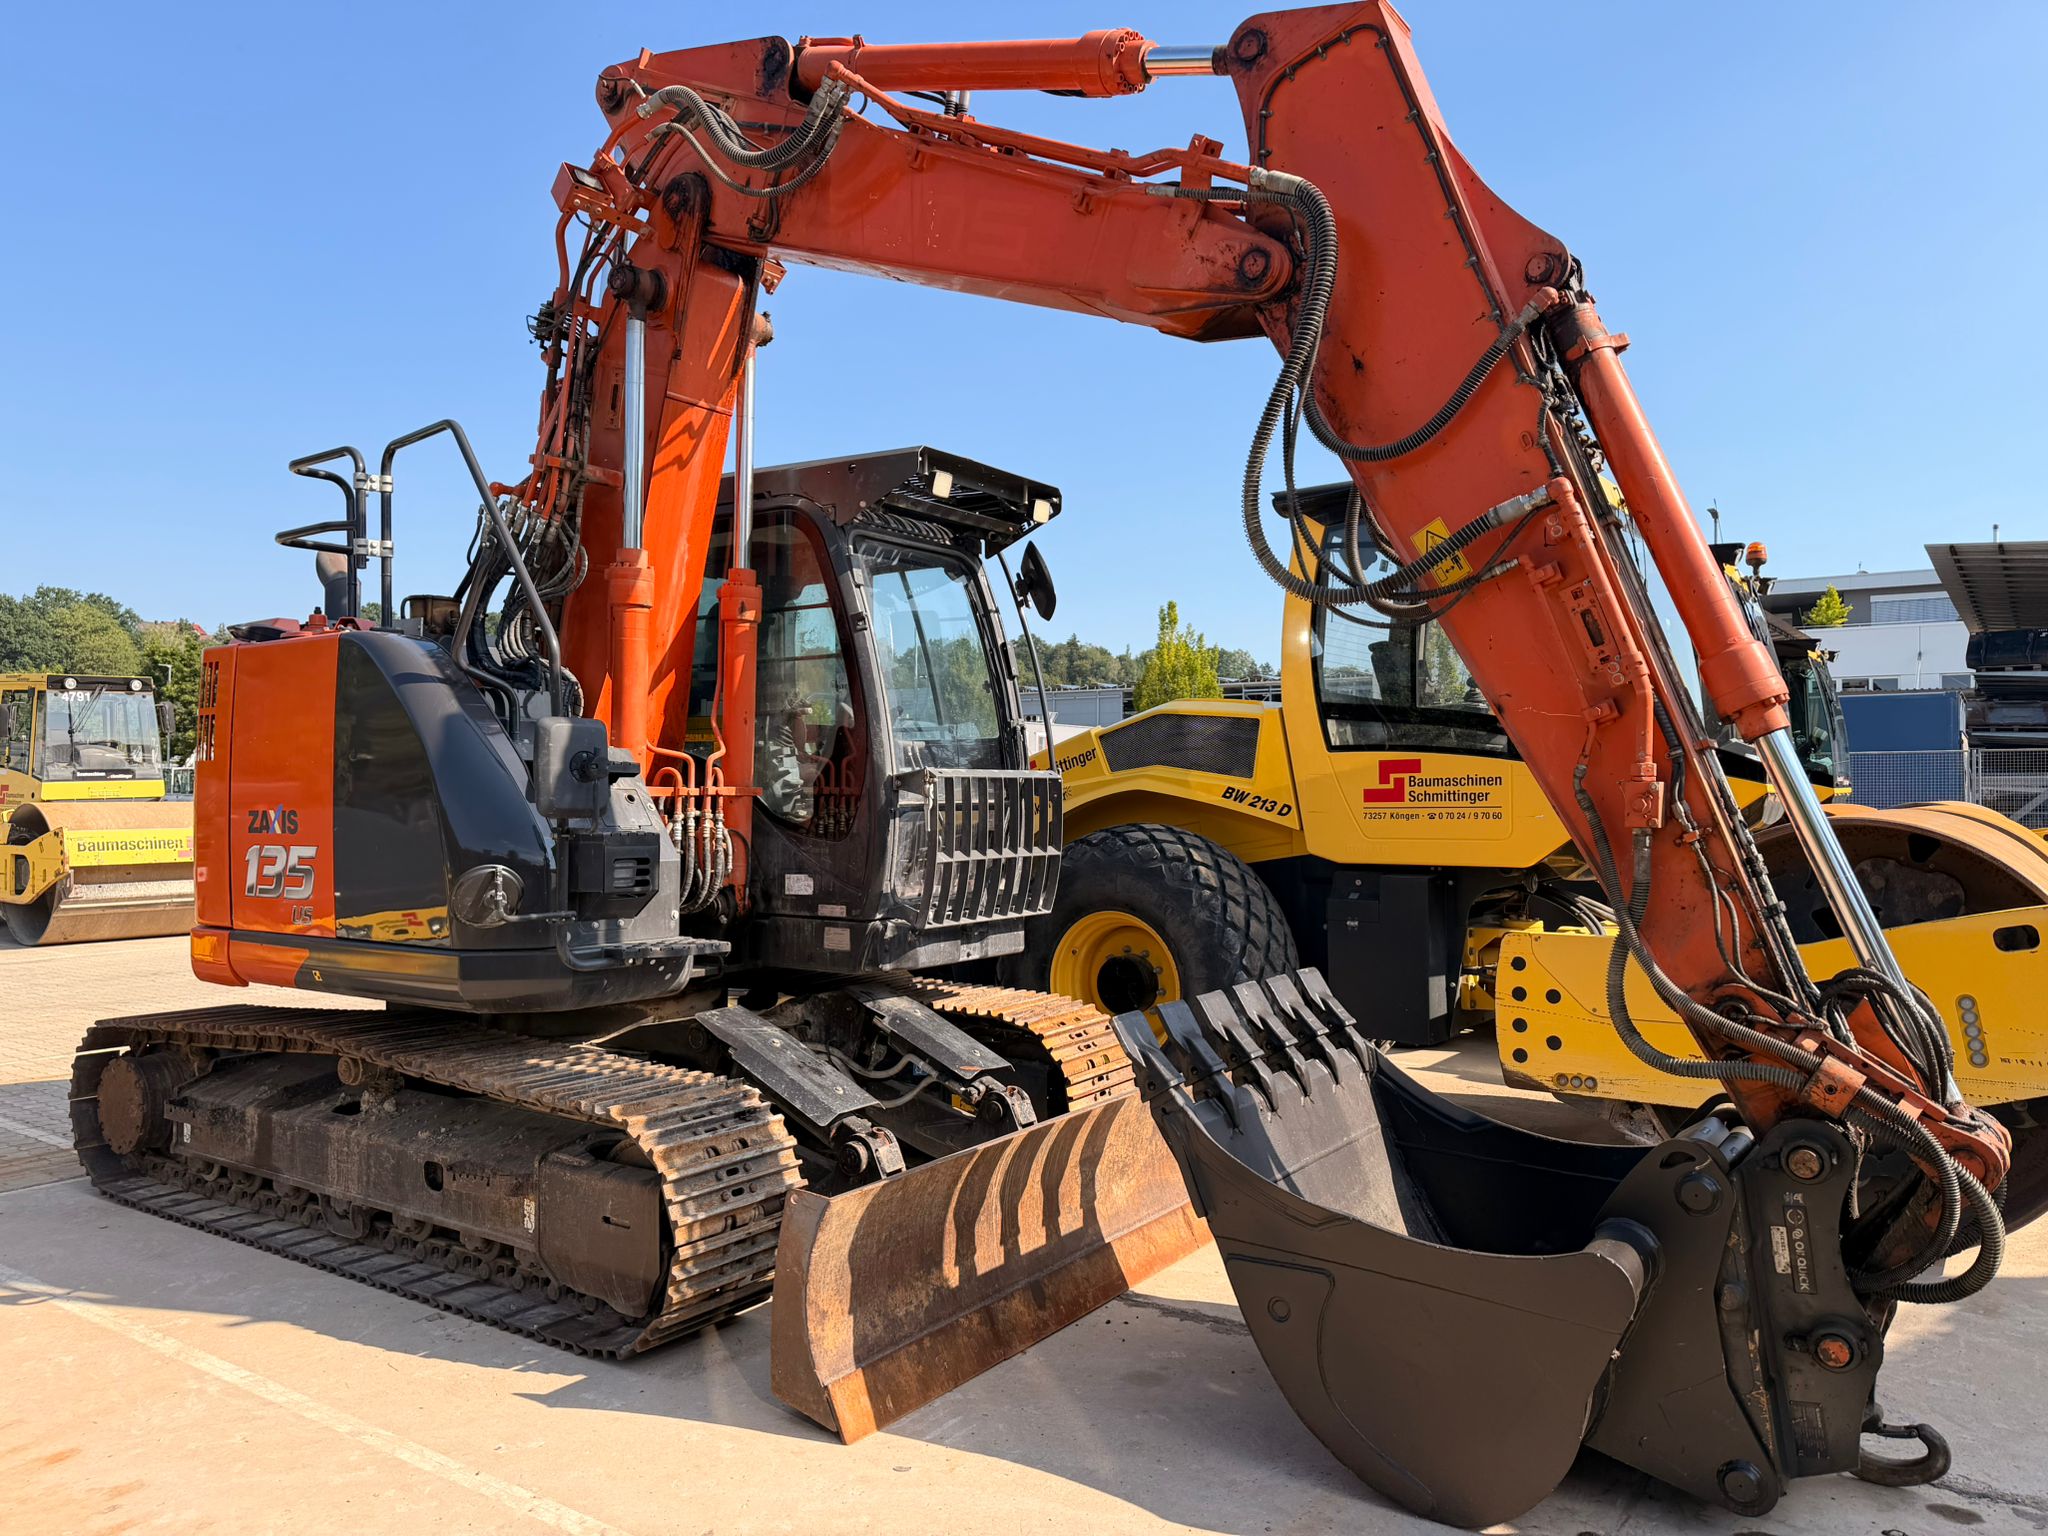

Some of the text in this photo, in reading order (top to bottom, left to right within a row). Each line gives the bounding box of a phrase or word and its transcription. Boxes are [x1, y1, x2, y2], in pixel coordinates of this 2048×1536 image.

[61, 691, 91, 702] 4791
[1046, 747, 1097, 775] ittinger
[1408, 774, 1503, 788] Baumaschinen
[1221, 786, 1293, 816] BW 213 D
[1408, 789, 1490, 804] Schmittinger
[248, 803, 299, 835] ZAXIS
[1363, 812, 1387, 820] 73257
[1389, 812, 1420, 821] Köngen
[1438, 812, 1444, 820] 0
[1445, 812, 1455, 820] 70
[1456, 812, 1466, 820] 24
[1473, 812, 1479, 820] 9
[1481, 812, 1491, 820] 70
[1492, 812, 1503, 820] 60
[77, 838, 184, 852] Baumaschinen
[245, 844, 319, 900] 135
[291, 905, 314, 926] US
